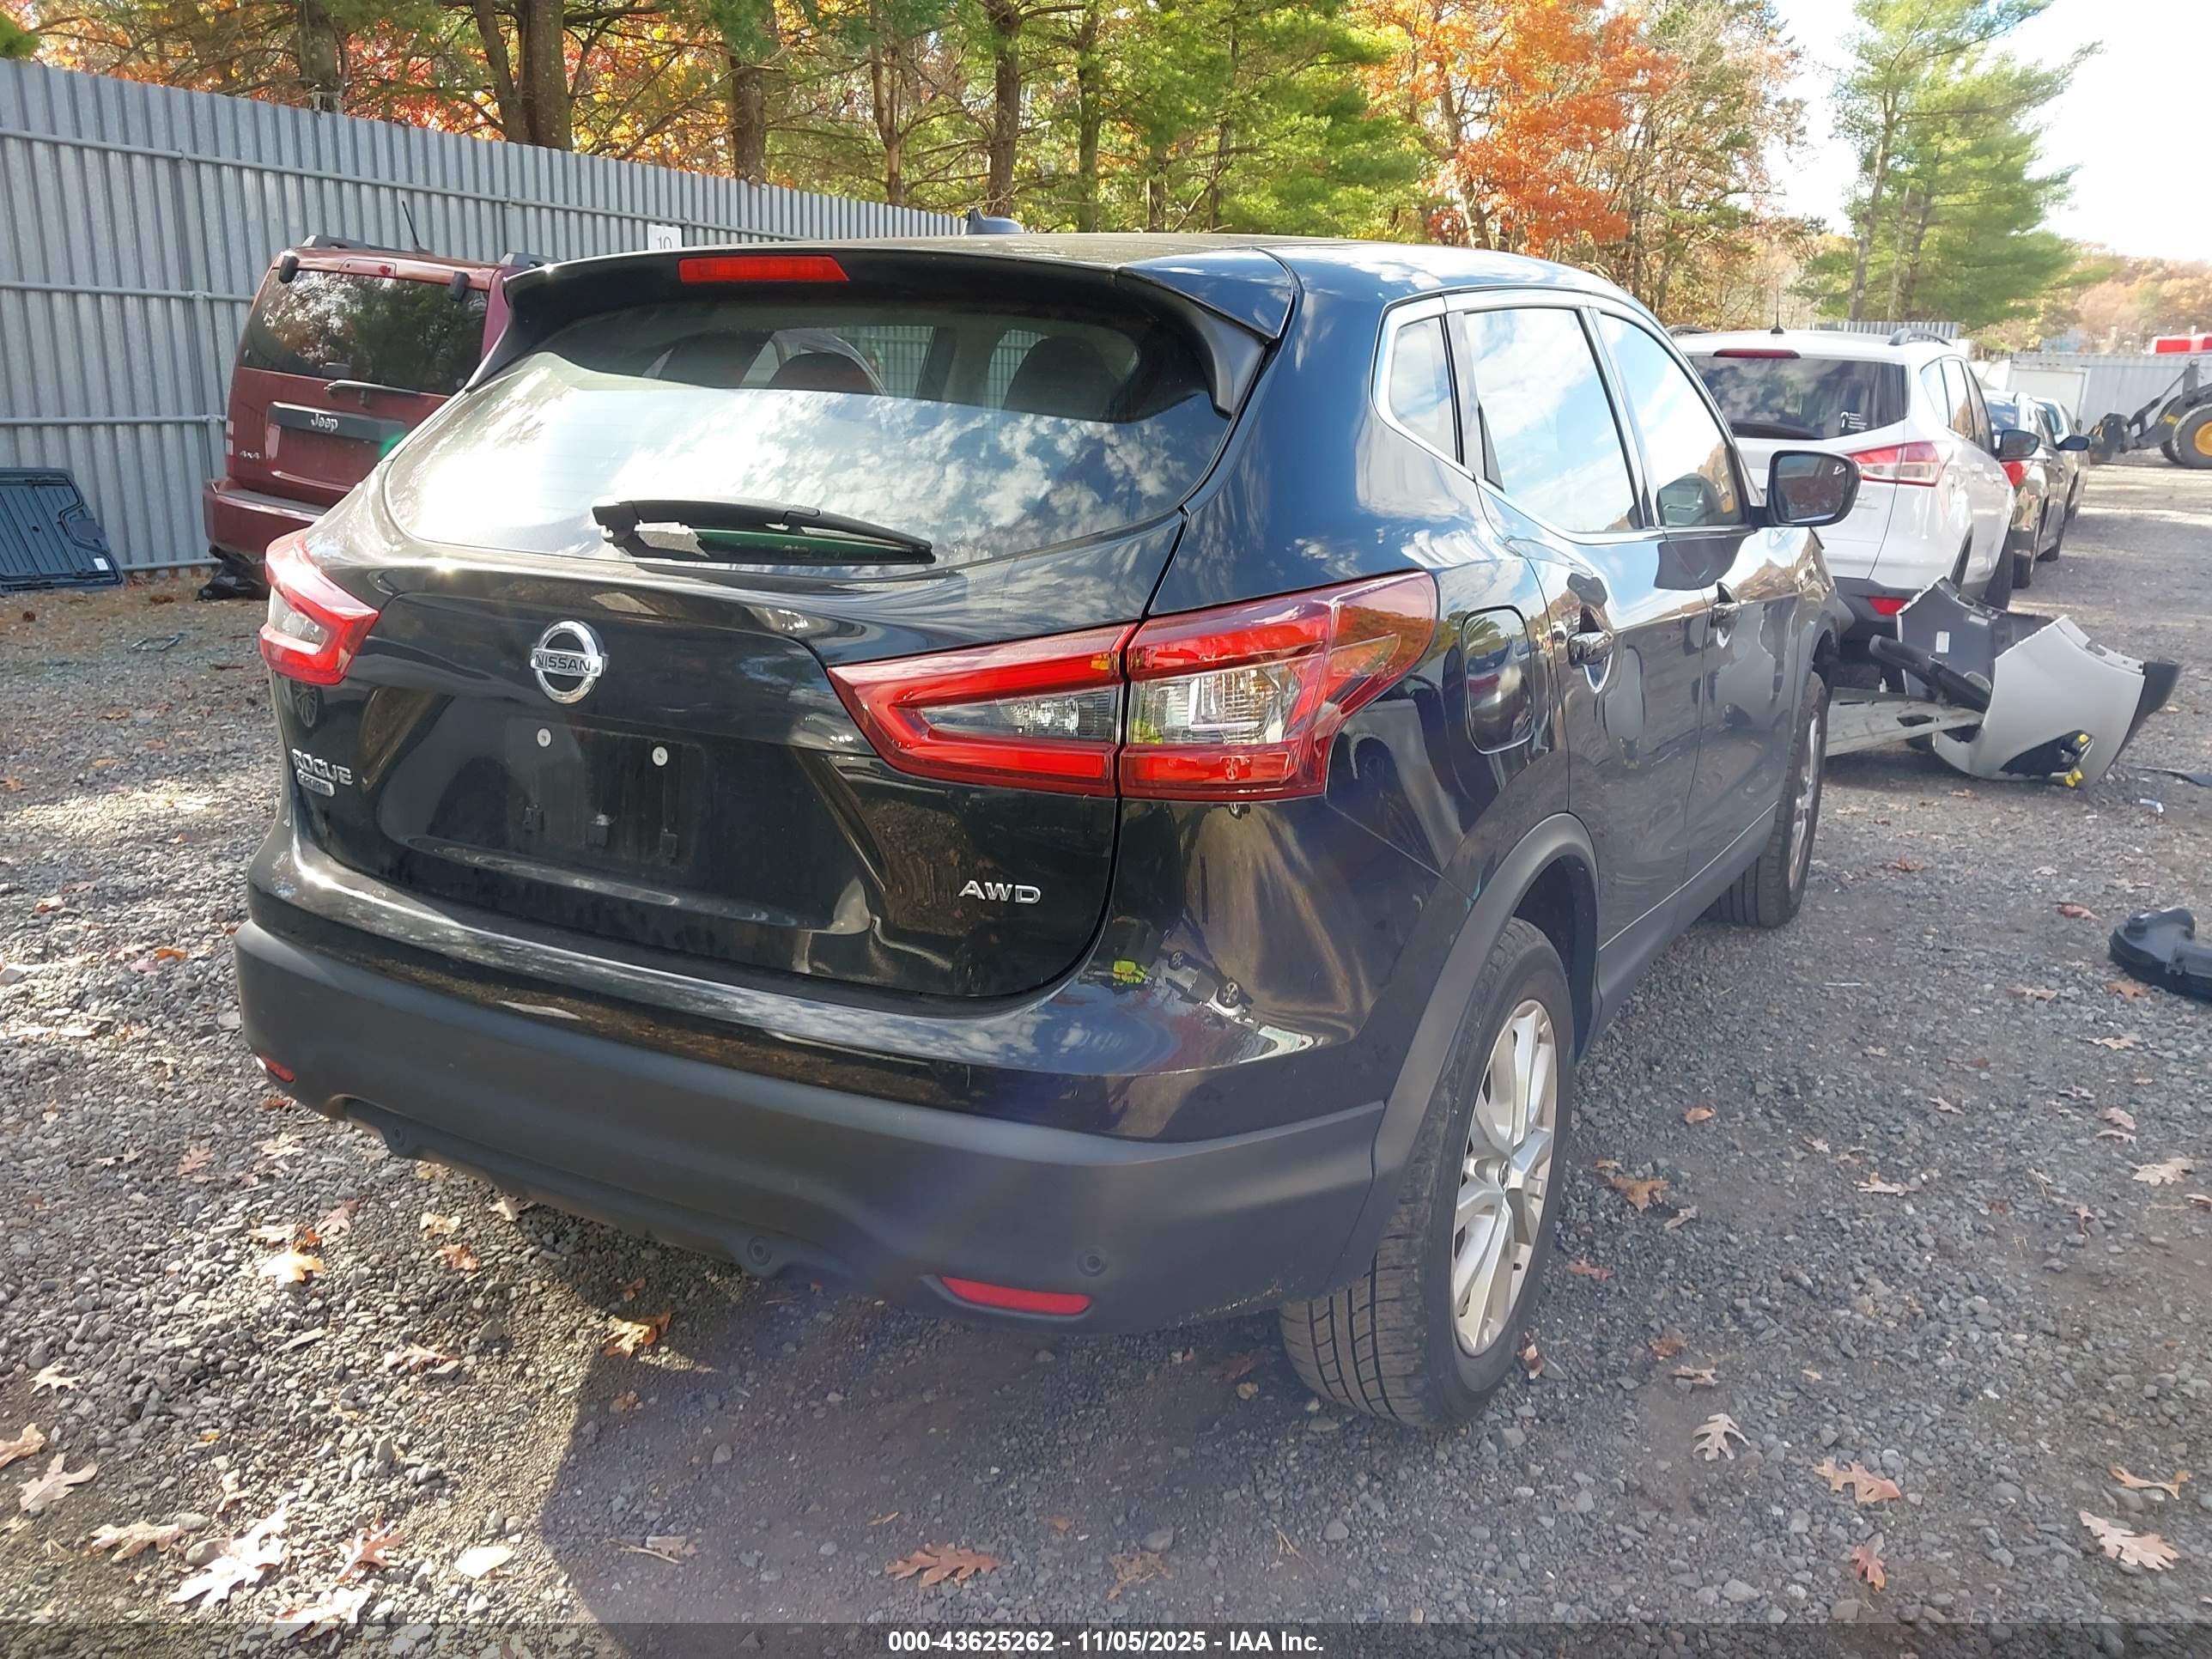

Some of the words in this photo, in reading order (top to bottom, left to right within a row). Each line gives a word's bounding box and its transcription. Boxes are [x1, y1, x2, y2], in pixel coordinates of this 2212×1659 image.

[310, 413, 338, 432] Jeep
[535, 654, 591, 672] NISSAN
[292, 748, 354, 786] ROGUE
[958, 880, 1042, 904] AWD
